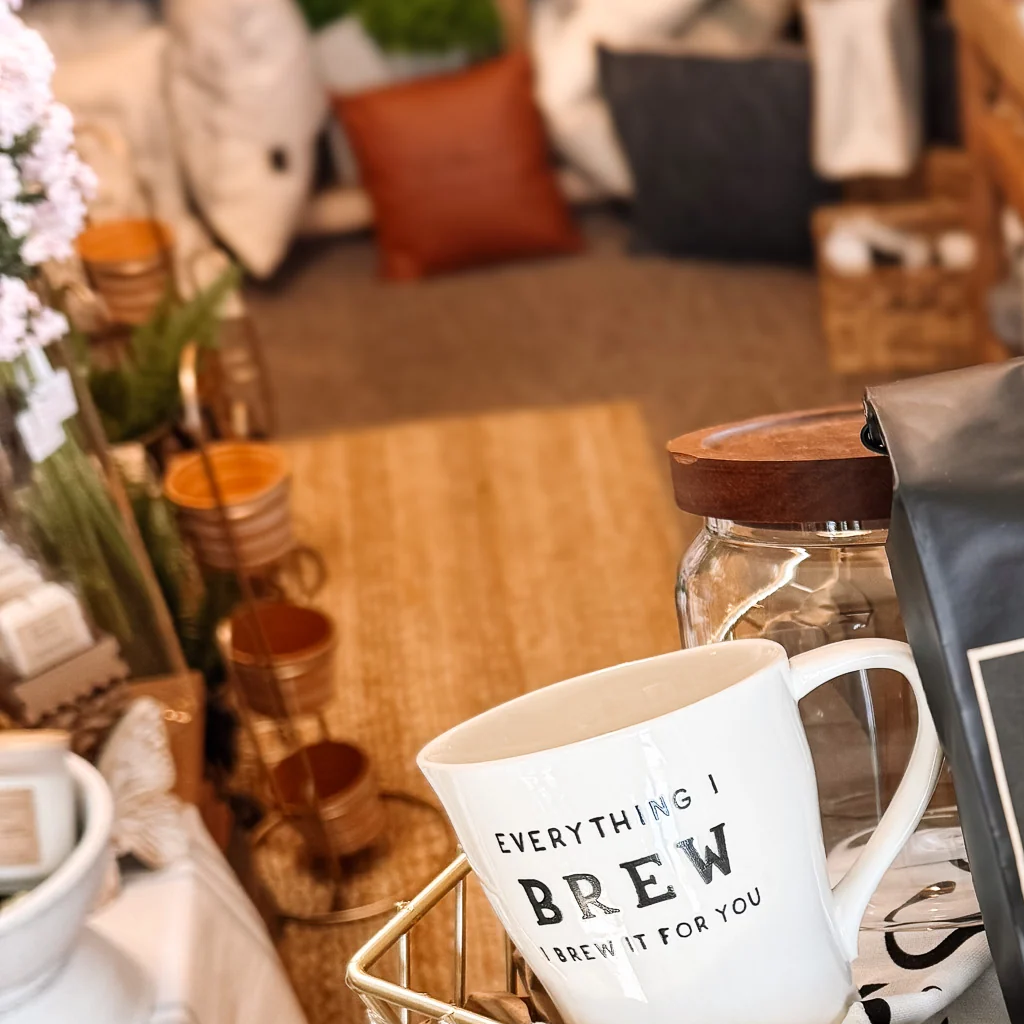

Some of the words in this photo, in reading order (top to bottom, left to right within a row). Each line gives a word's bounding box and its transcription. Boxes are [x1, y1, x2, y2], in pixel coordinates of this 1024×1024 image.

[495, 788, 692, 853] EVERYTHING
[708, 774, 719, 794] I
[518, 822, 731, 926] BREW
[540, 946, 551, 962] I
[553, 940, 616, 963] BREW
[625, 933, 648, 953] IT
[658, 915, 709, 945] FOR
[715, 887, 761, 923] YOU
